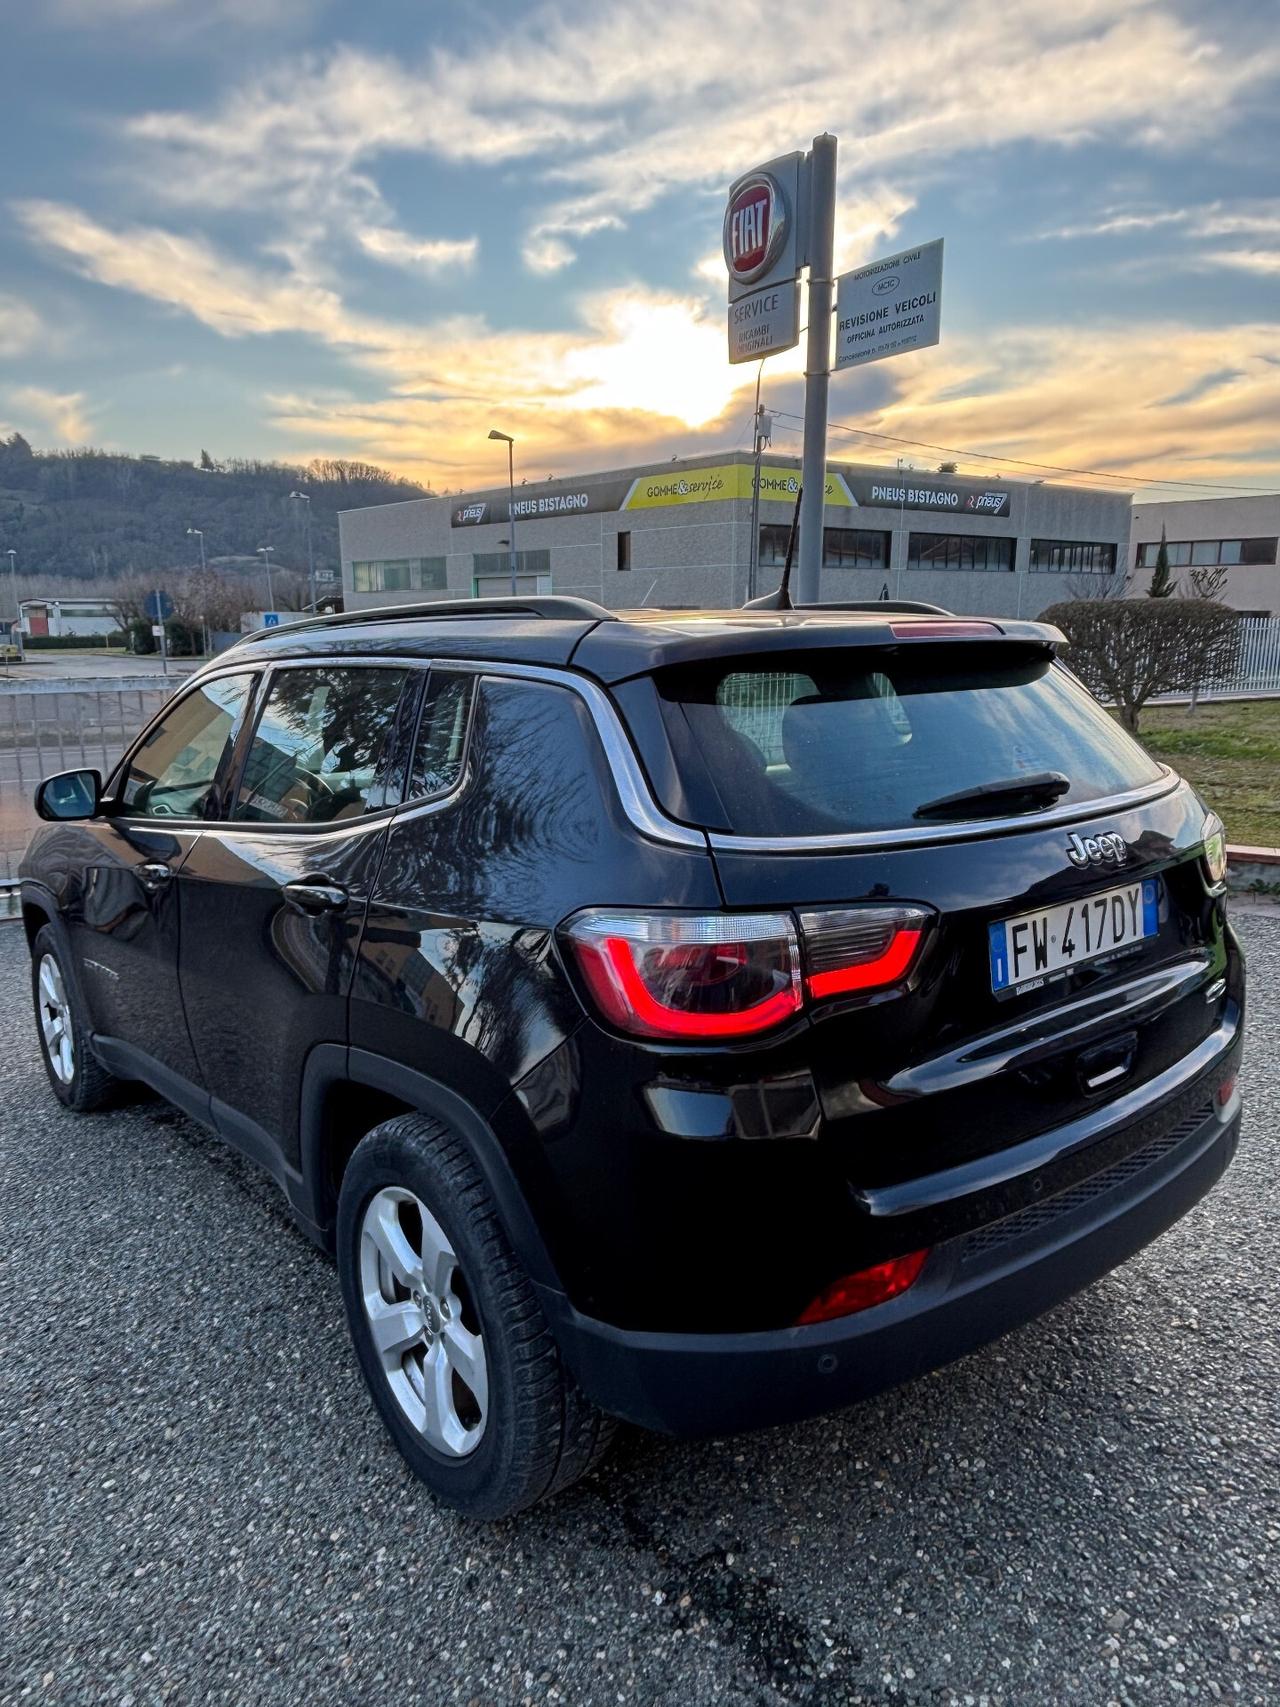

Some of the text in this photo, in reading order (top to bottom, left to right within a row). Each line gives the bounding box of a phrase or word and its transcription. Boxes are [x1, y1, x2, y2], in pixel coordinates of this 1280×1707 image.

[732, 199, 768, 258] FIAT
[903, 251, 921, 264] CIVILE
[734, 294, 779, 325] SERVICE
[839, 291, 937, 332] REVISIONE VEICOLI
[846, 328, 876, 344] OFFICINA
[878, 314, 925, 335] AUTORIZZATA
[508, 493, 589, 515] NEUS BISTAGNO
[872, 486, 959, 506] PNEUS BISTAGNO
[1066, 831, 1127, 869] Jeep
[1012, 887, 1140, 978] FW 417DY
